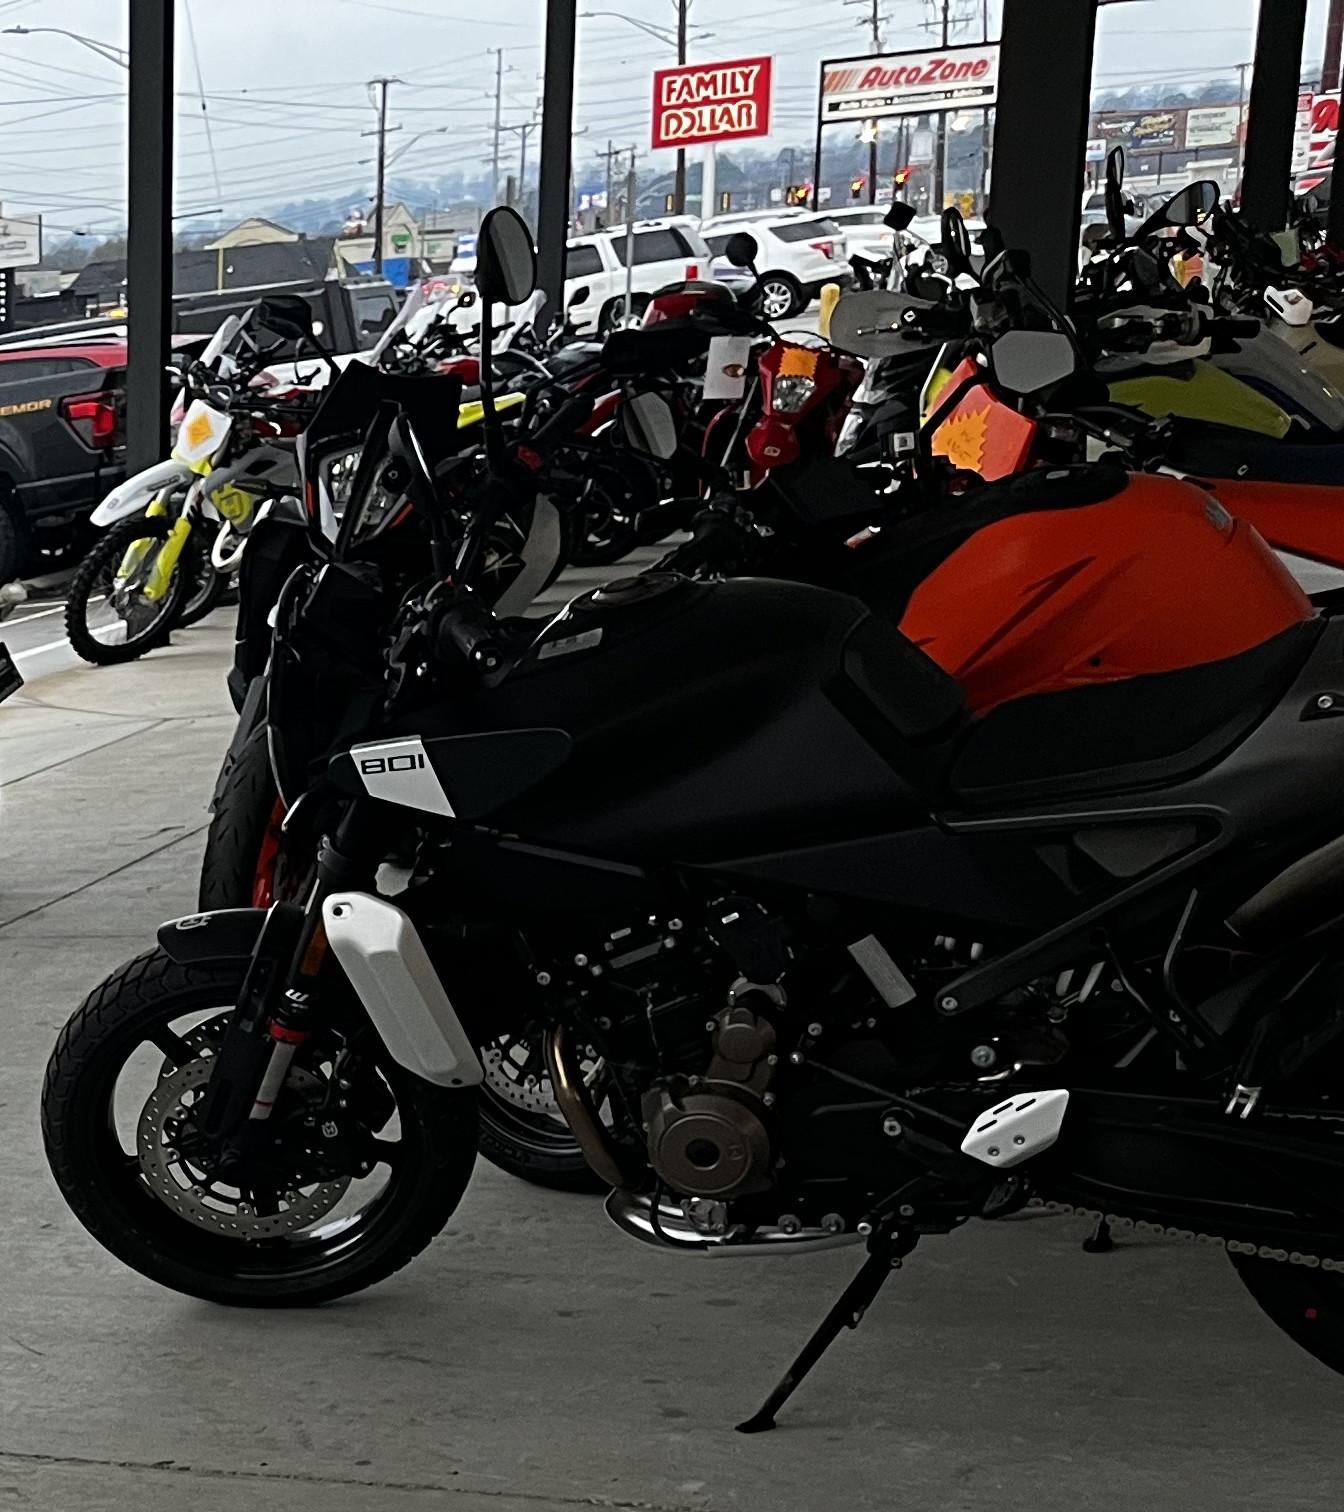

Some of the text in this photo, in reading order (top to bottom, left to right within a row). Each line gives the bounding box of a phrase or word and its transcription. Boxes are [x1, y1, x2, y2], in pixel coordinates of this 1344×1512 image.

[662, 65, 761, 106] FAMILY
[858, 58, 990, 90] AutoZone
[659, 100, 758, 140] DOLLAR
[360, 753, 425, 775] 801
